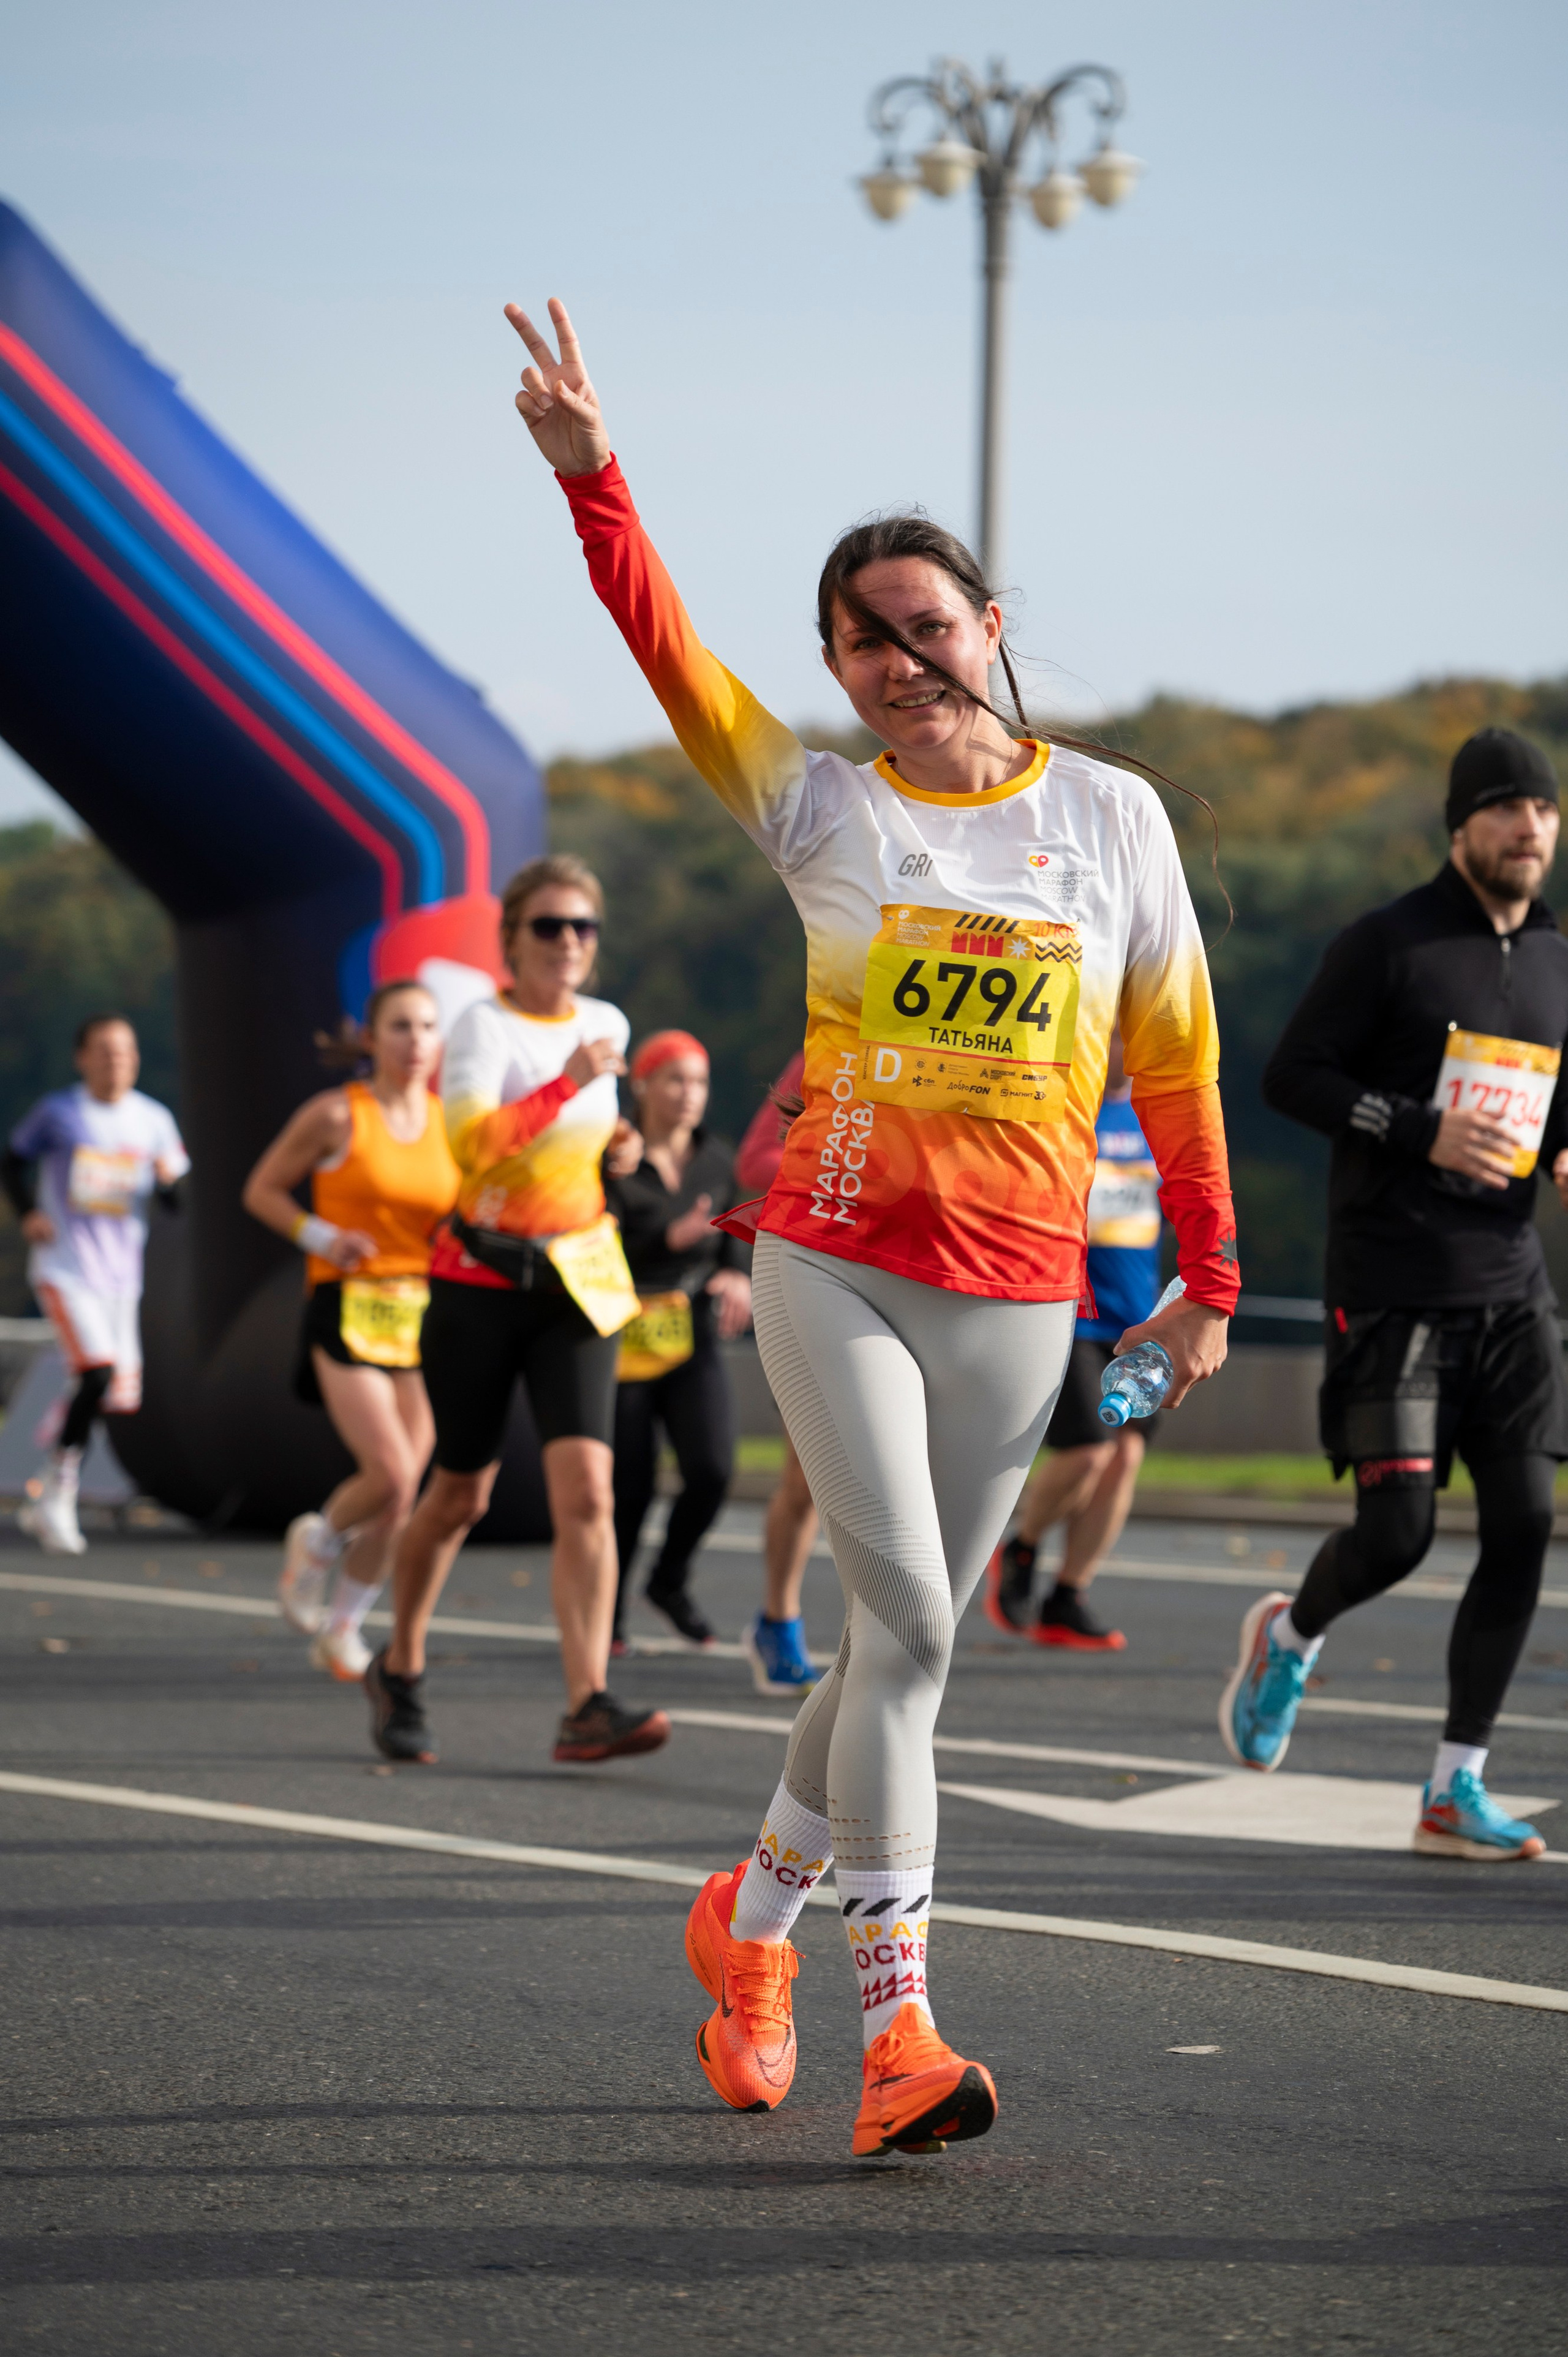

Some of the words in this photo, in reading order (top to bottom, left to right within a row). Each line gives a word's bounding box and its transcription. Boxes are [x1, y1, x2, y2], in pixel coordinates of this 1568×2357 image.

[898, 853, 933, 877] GRI
[1038, 869, 1099, 878] МОСКОВСКИЙ
[1041, 886, 1078, 895] MOSCOW
[897, 927, 929, 935] МАРАФОН
[898, 921, 941, 932] МОСКОВСКИЙ
[896, 938, 930, 947] MARATHON
[893, 959, 1052, 1032] 6794
[929, 1027, 1014, 1054] ТАТЬЯНА
[874, 1047, 902, 1083] D
[809, 1051, 858, 1219] МАРАФОН
[855, 1942, 926, 1972] ОСКВ
